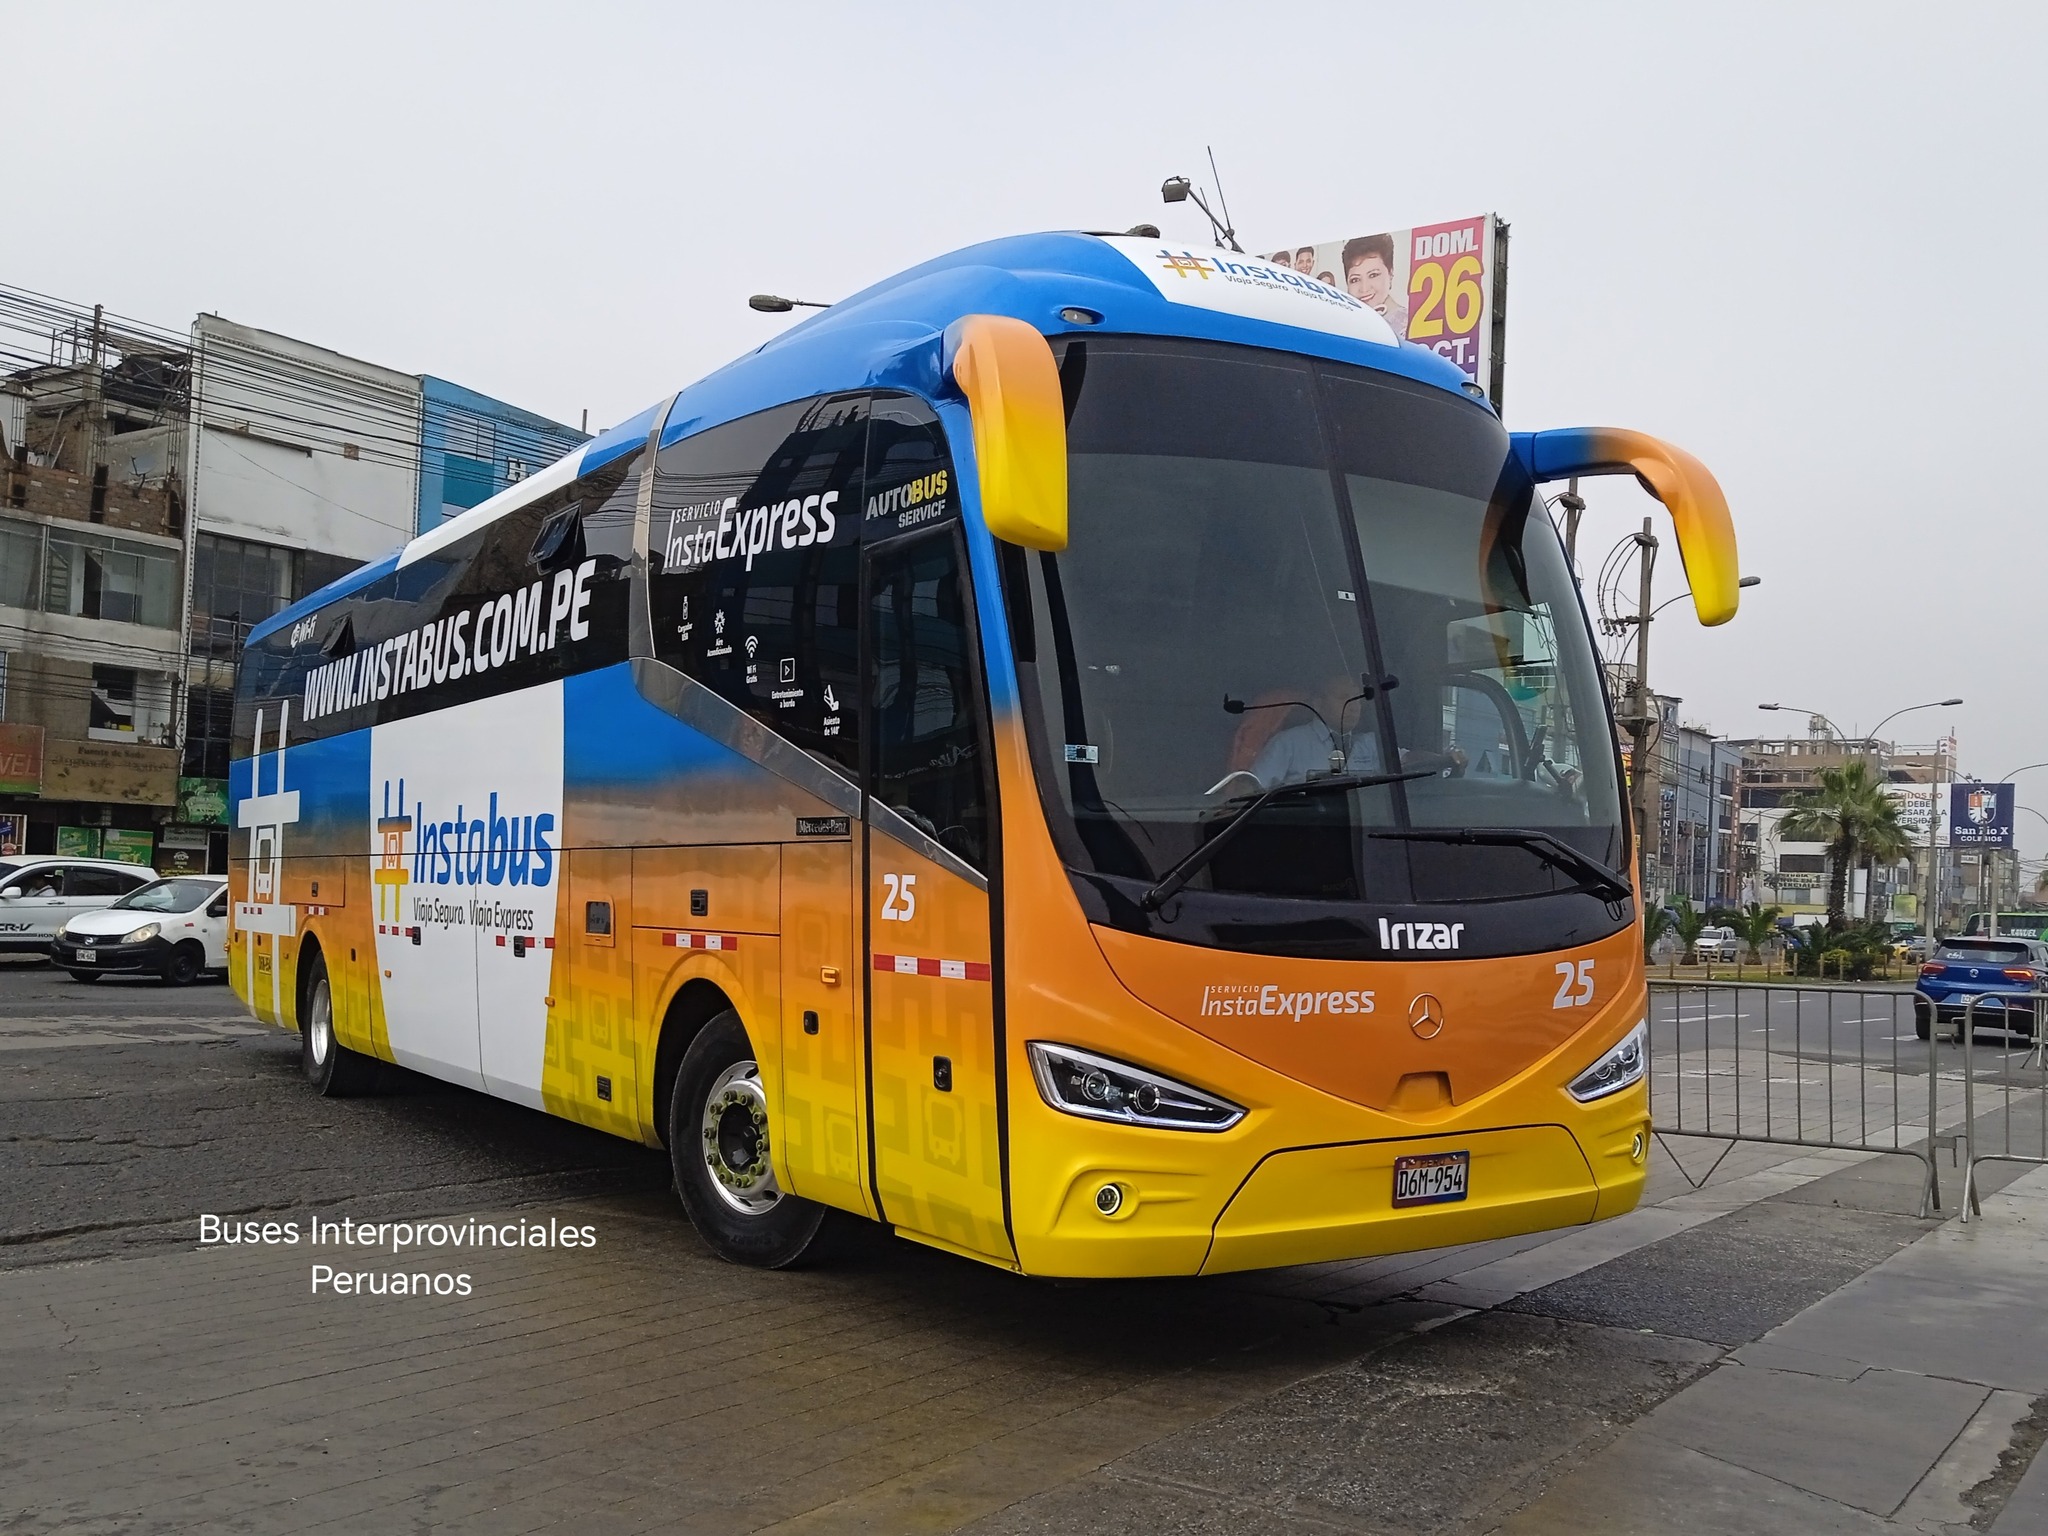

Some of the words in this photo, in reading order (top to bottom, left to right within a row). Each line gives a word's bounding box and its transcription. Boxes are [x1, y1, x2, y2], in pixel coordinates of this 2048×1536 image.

[1415, 227, 1479, 261] DOM.
[1225, 275, 1252, 286] Viaja
[1318, 294, 1354, 312] Express
[1408, 255, 1482, 339] 26
[1419, 337, 1476, 365] CT.
[675, 499, 722, 524] SERVICIO
[865, 469, 949, 521] AUTOBUS
[663, 490, 840, 572] InstaExpress
[303, 558, 597, 722] WWW.INSTABUS.COM.PE
[771, 688, 804, 700] Entretenimiento
[799, 819, 848, 834] Mercedes-Benz
[1662, 802, 1672, 854] DENTAL
[1954, 826, 1977, 835] San
[1999, 826, 2009, 835] X
[413, 897, 433, 927] Viaja
[469, 900, 492, 932] Viaja
[494, 901, 534, 935] Express
[881, 873, 917, 922] 25
[1378, 917, 1465, 951] Irizar
[1210, 985, 1260, 994] SERVICIO
[1552, 958, 1595, 1010] 25
[1201, 985, 1375, 1023] InstaExpress
[1397, 1165, 1463, 1198] D6M-954
